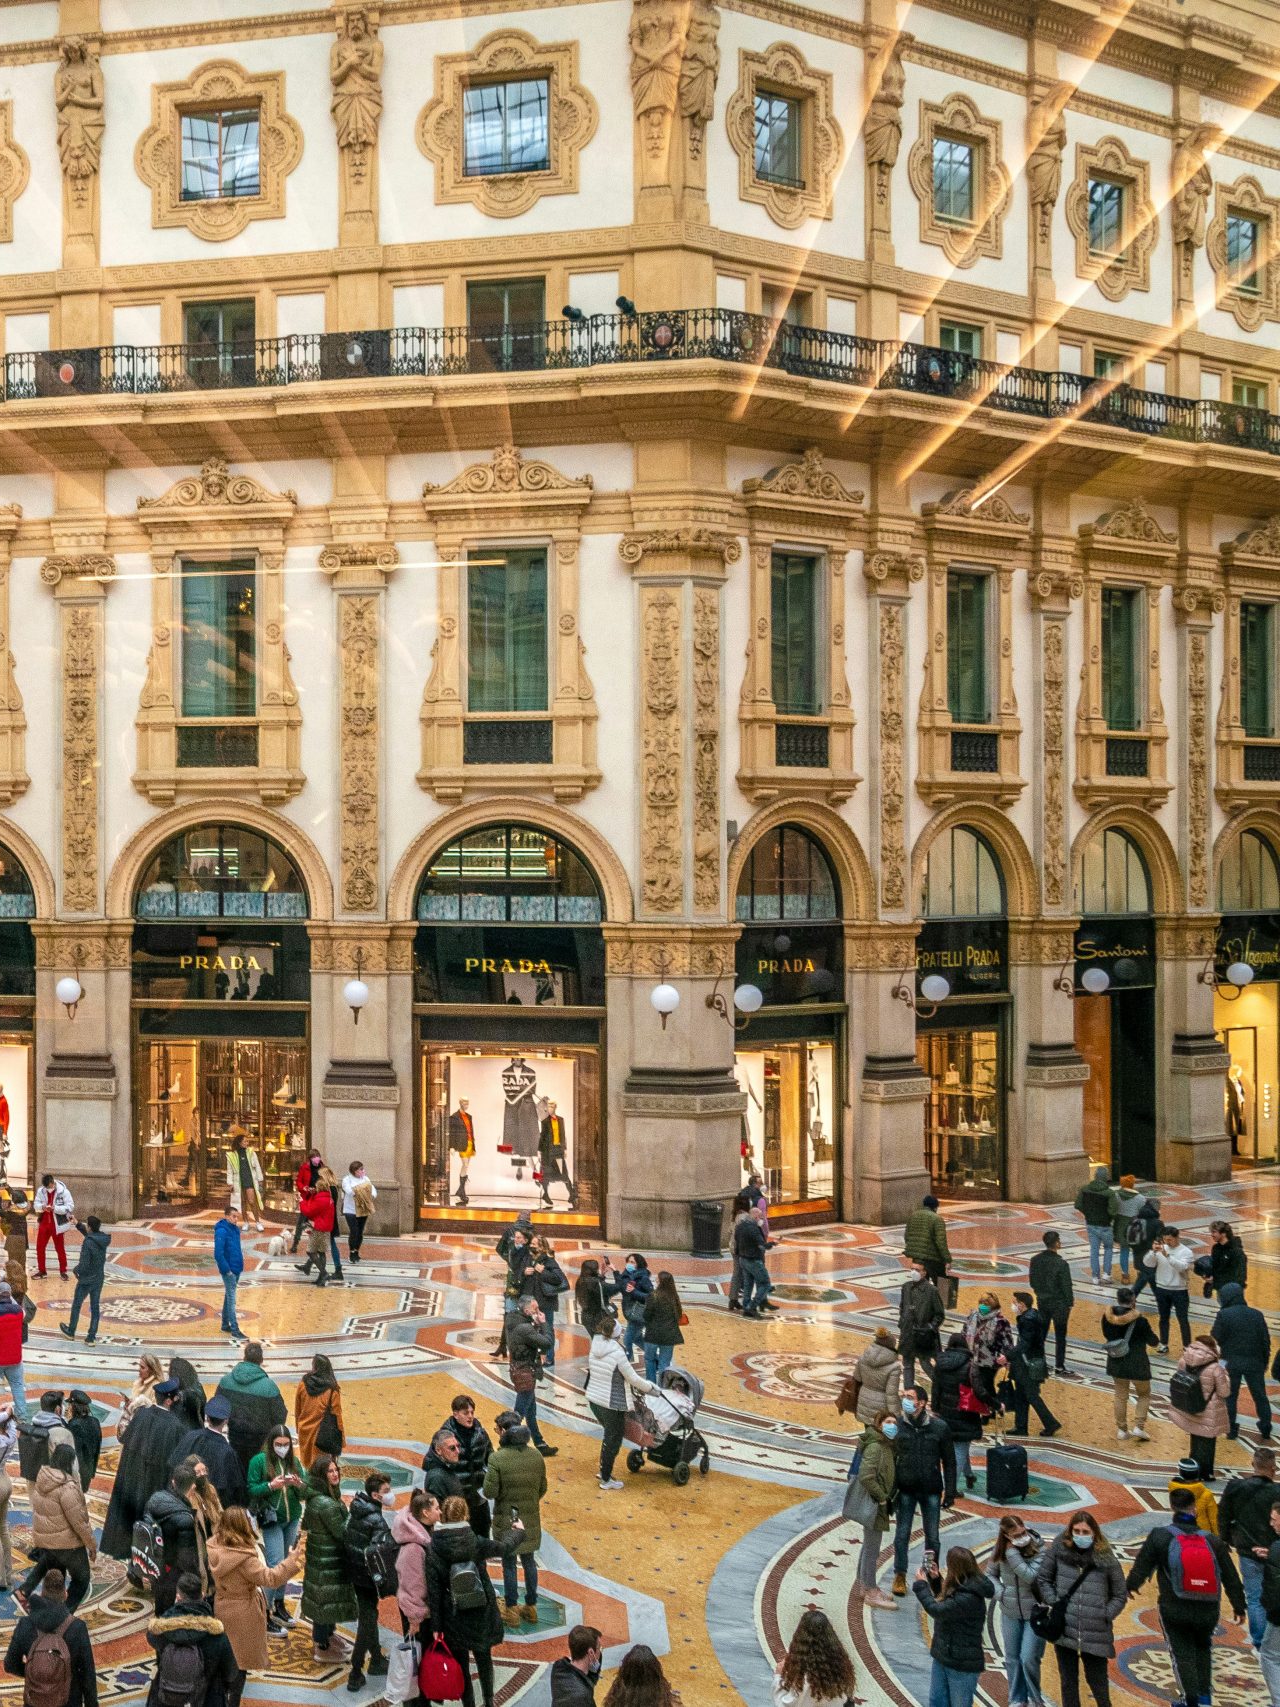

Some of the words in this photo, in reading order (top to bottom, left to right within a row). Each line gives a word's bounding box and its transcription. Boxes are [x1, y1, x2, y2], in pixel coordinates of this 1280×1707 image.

[916, 947, 963, 968] FRATELLI
[966, 945, 1000, 966] PRADA
[1074, 941, 1149, 960] Santoni
[180, 955, 261, 970] PRADA
[465, 958, 552, 974] PRADA
[758, 958, 815, 974] PRADA
